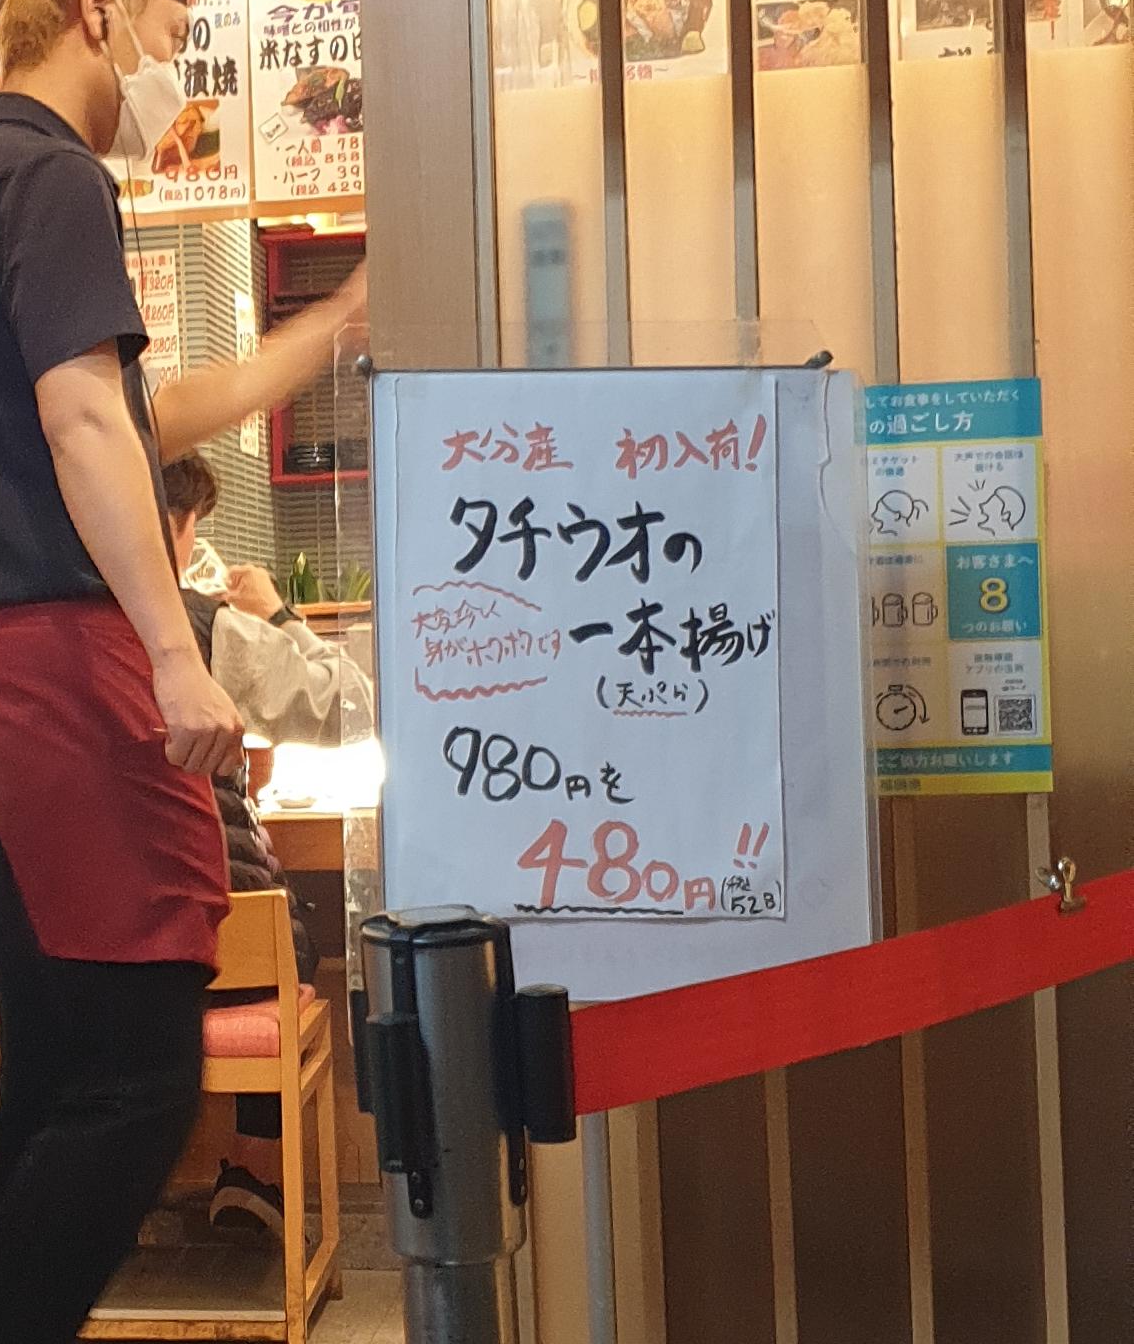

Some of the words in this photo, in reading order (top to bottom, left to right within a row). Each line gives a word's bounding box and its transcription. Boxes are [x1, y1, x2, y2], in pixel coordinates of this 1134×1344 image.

[442, 422, 574, 474] 大分産
[615, 413, 767, 479] 初入荷!
[868, 410, 974, 436] の過ごし方
[448, 496, 704, 584] タチウオの
[980, 577, 1010, 614] 8
[568, 597, 776, 676] 一本揚げ
[596, 675, 711, 711] (天ぷら)
